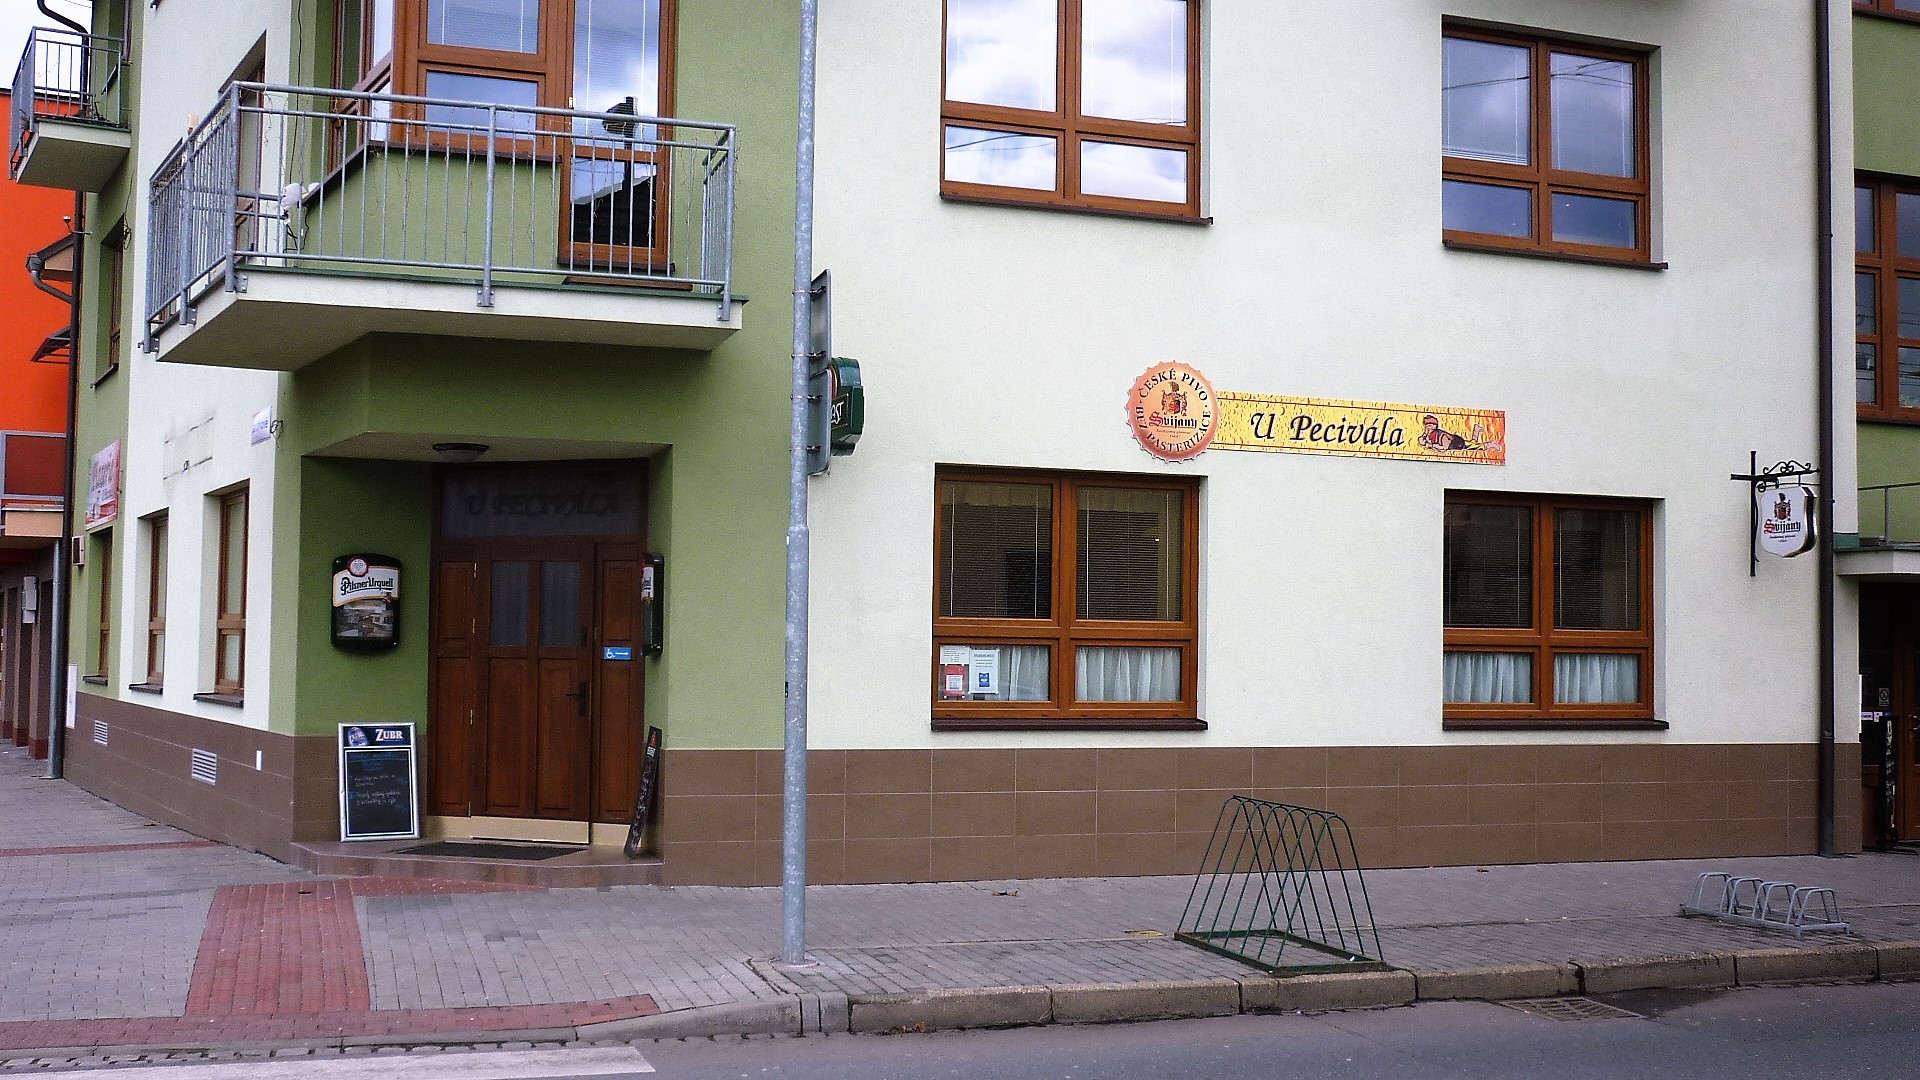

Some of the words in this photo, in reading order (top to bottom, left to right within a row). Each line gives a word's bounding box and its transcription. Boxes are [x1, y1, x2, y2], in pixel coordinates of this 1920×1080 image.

[1138, 367, 1178, 399] ČESKÉ
[1180, 372, 1209, 402] PIVO
[1148, 410, 1198, 429] Svijany
[1250, 412, 1276, 439] U
[1289, 414, 1405, 447] Pecivála
[1763, 518, 1801, 534] Svijany
[340, 576, 369, 596] Pilsner
[368, 576, 394, 591] Urquell
[374, 728, 404, 742] ZUBR
